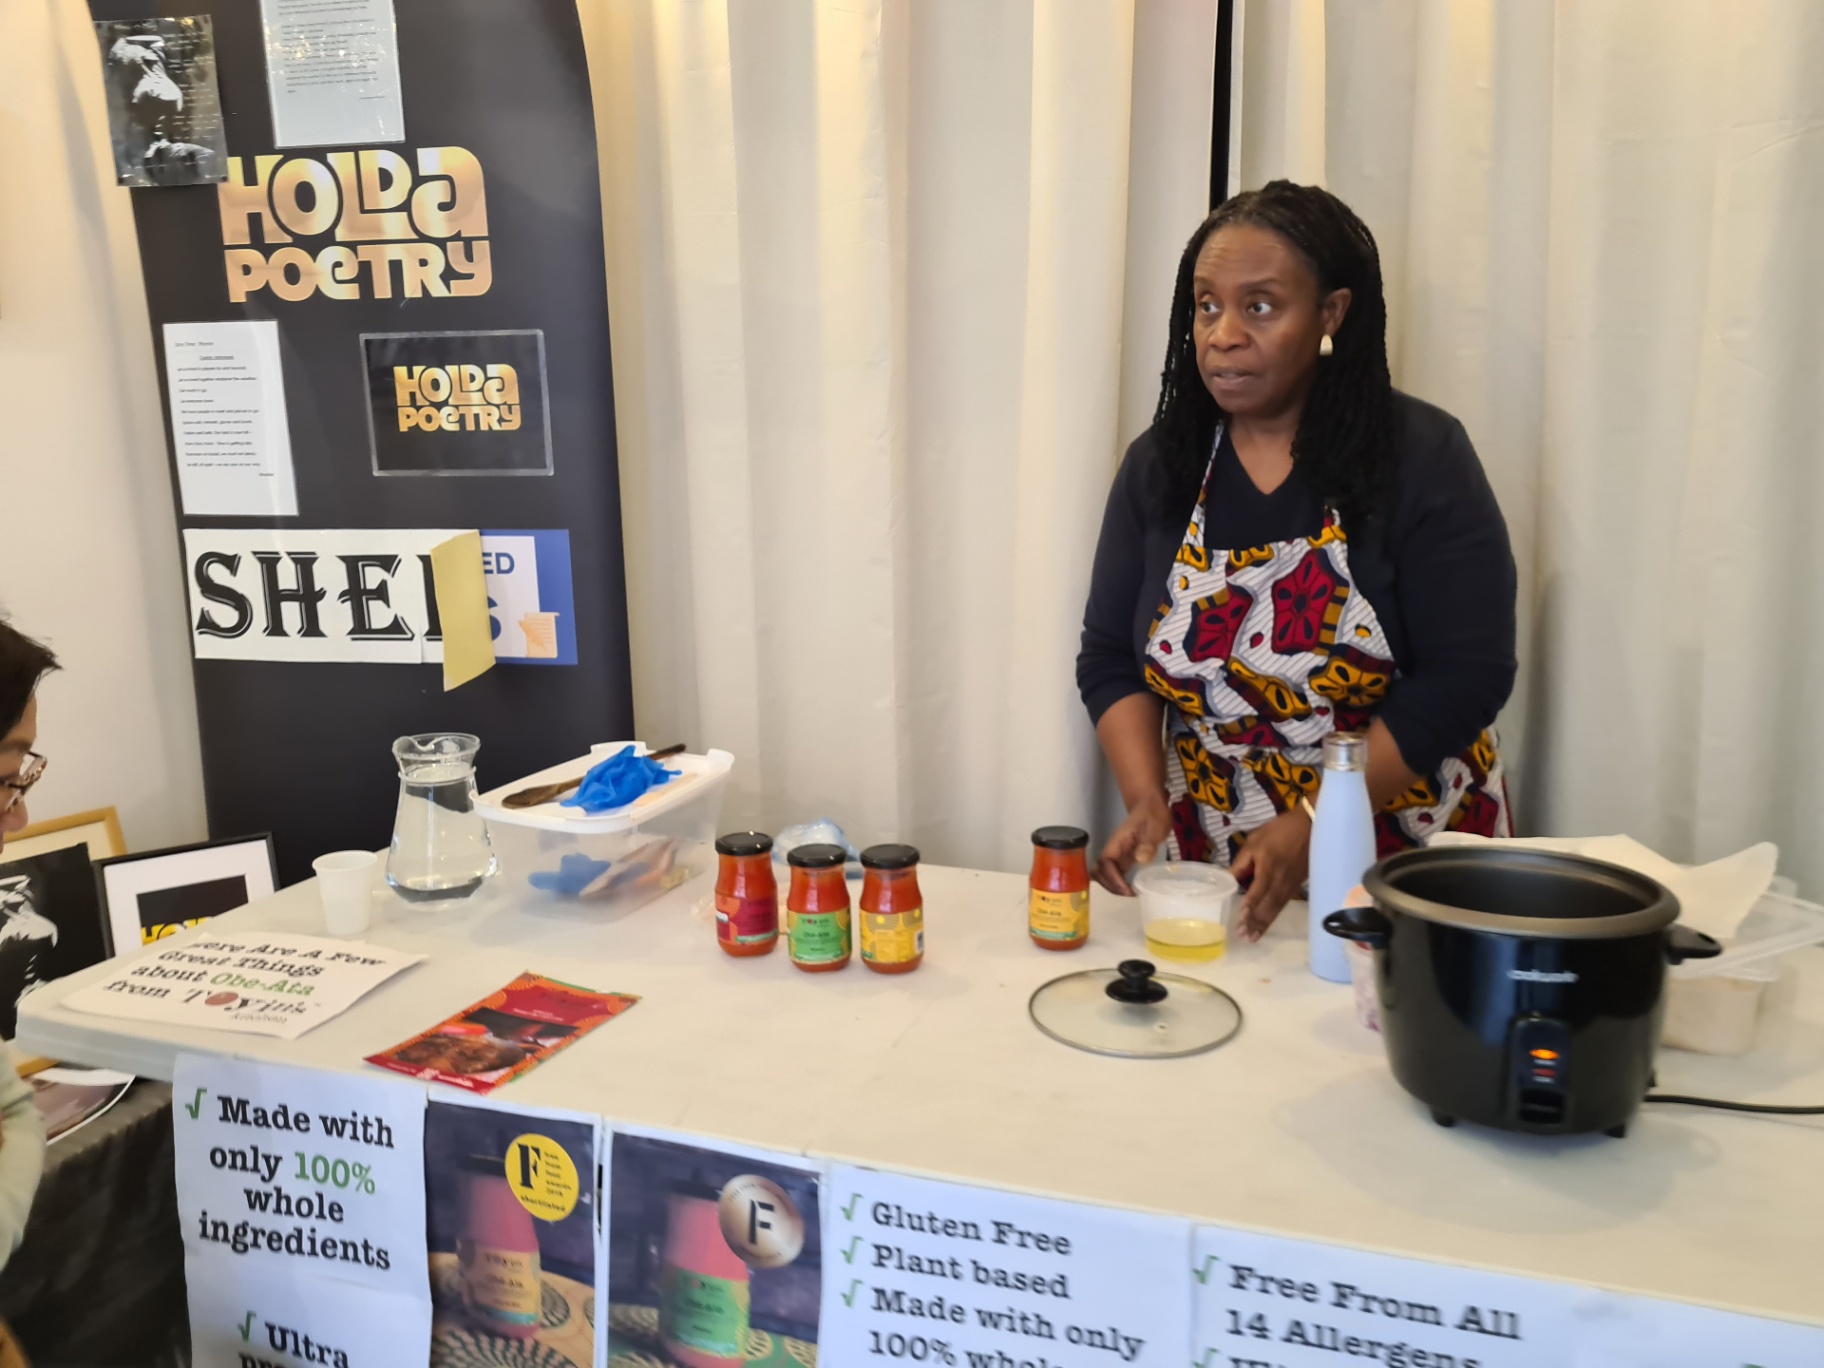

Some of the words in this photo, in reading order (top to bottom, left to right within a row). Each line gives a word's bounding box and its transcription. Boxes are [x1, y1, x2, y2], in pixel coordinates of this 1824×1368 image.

[158, 950, 232, 967] Great
[232, 956, 325, 978] Things
[246, 943, 298, 956] Are
[103, 979, 170, 999] from
[130, 962, 208, 984] about
[210, 972, 315, 996] Obe-Ata
[216, 1094, 311, 1133] Made
[319, 1111, 395, 1149] with
[209, 1145, 283, 1182] only
[294, 1151, 376, 1194] 100%
[516, 1142, 541, 1190] F
[244, 1187, 344, 1222] whole
[872, 1201, 983, 1242] Gluten
[990, 1219, 1073, 1256] Free
[199, 1211, 391, 1271] ingredients
[871, 1243, 963, 1281] Plant
[970, 1259, 1072, 1299] based
[871, 1286, 967, 1325] Made
[974, 1307, 1057, 1341] with
[1065, 1324, 1147, 1362] only
[1228, 1263, 1319, 1303] Free
[1330, 1281, 1445, 1327] From
[1454, 1305, 1523, 1341] All
[264, 1320, 348, 1368] Ultra
[869, 1329, 958, 1367] 100%
[1225, 1308, 1271, 1340] 14
[1280, 1319, 1482, 1368] Allergens
